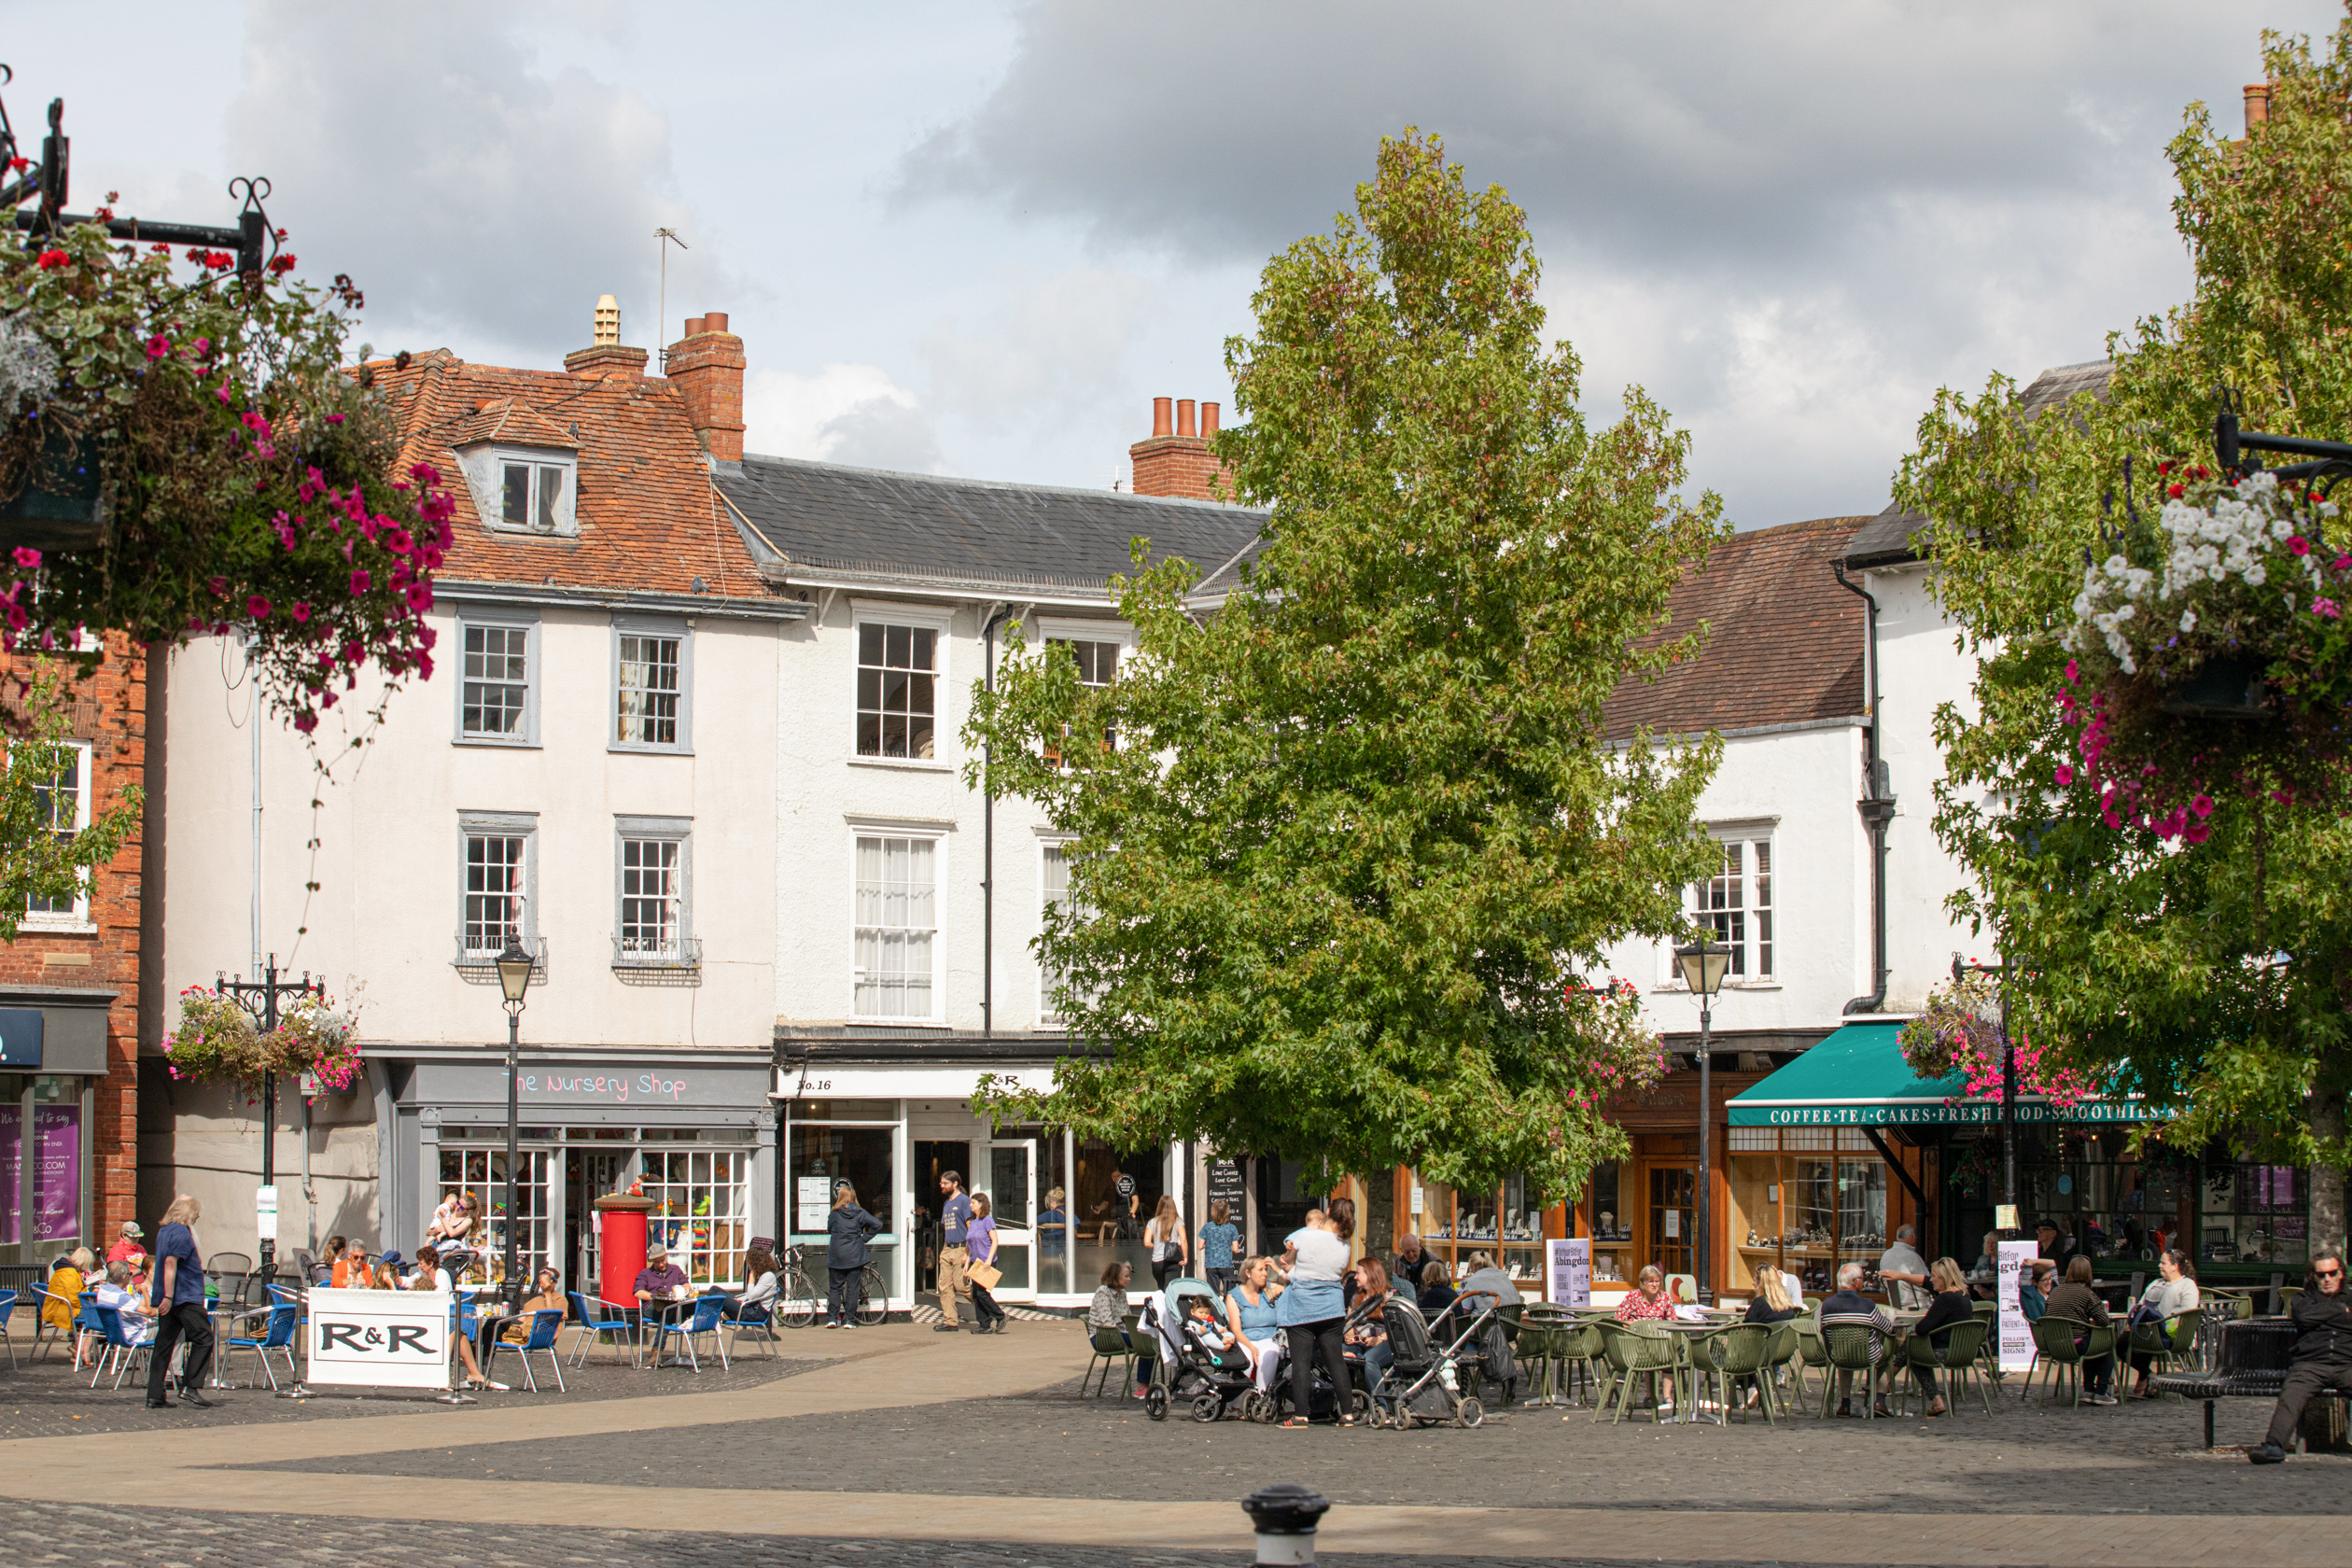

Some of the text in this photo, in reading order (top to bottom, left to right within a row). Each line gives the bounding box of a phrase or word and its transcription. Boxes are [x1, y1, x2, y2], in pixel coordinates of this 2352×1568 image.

[501, 1072, 686, 1101] he Nursery Shop
[796, 1080, 832, 1090] No. 16
[1, 1112, 14, 1125] We
[46, 1112, 55, 1124] to
[56, 1114, 70, 1127] say
[1770, 1109, 1832, 1124] COFFEE
[1838, 1109, 1867, 1123] TEA
[1876, 1108, 1931, 1123] CAKES
[1938, 1107, 1992, 1121] FRESH
[1996, 1106, 2044, 1121] FOD
[33, 1222, 52, 1235] &Co
[872, 1234, 896, 1242] Cream
[1555, 1257, 1589, 1268] Abingdon
[2001, 1320, 2021, 1328] PATIENT
[319, 1322, 439, 1355] R&R
